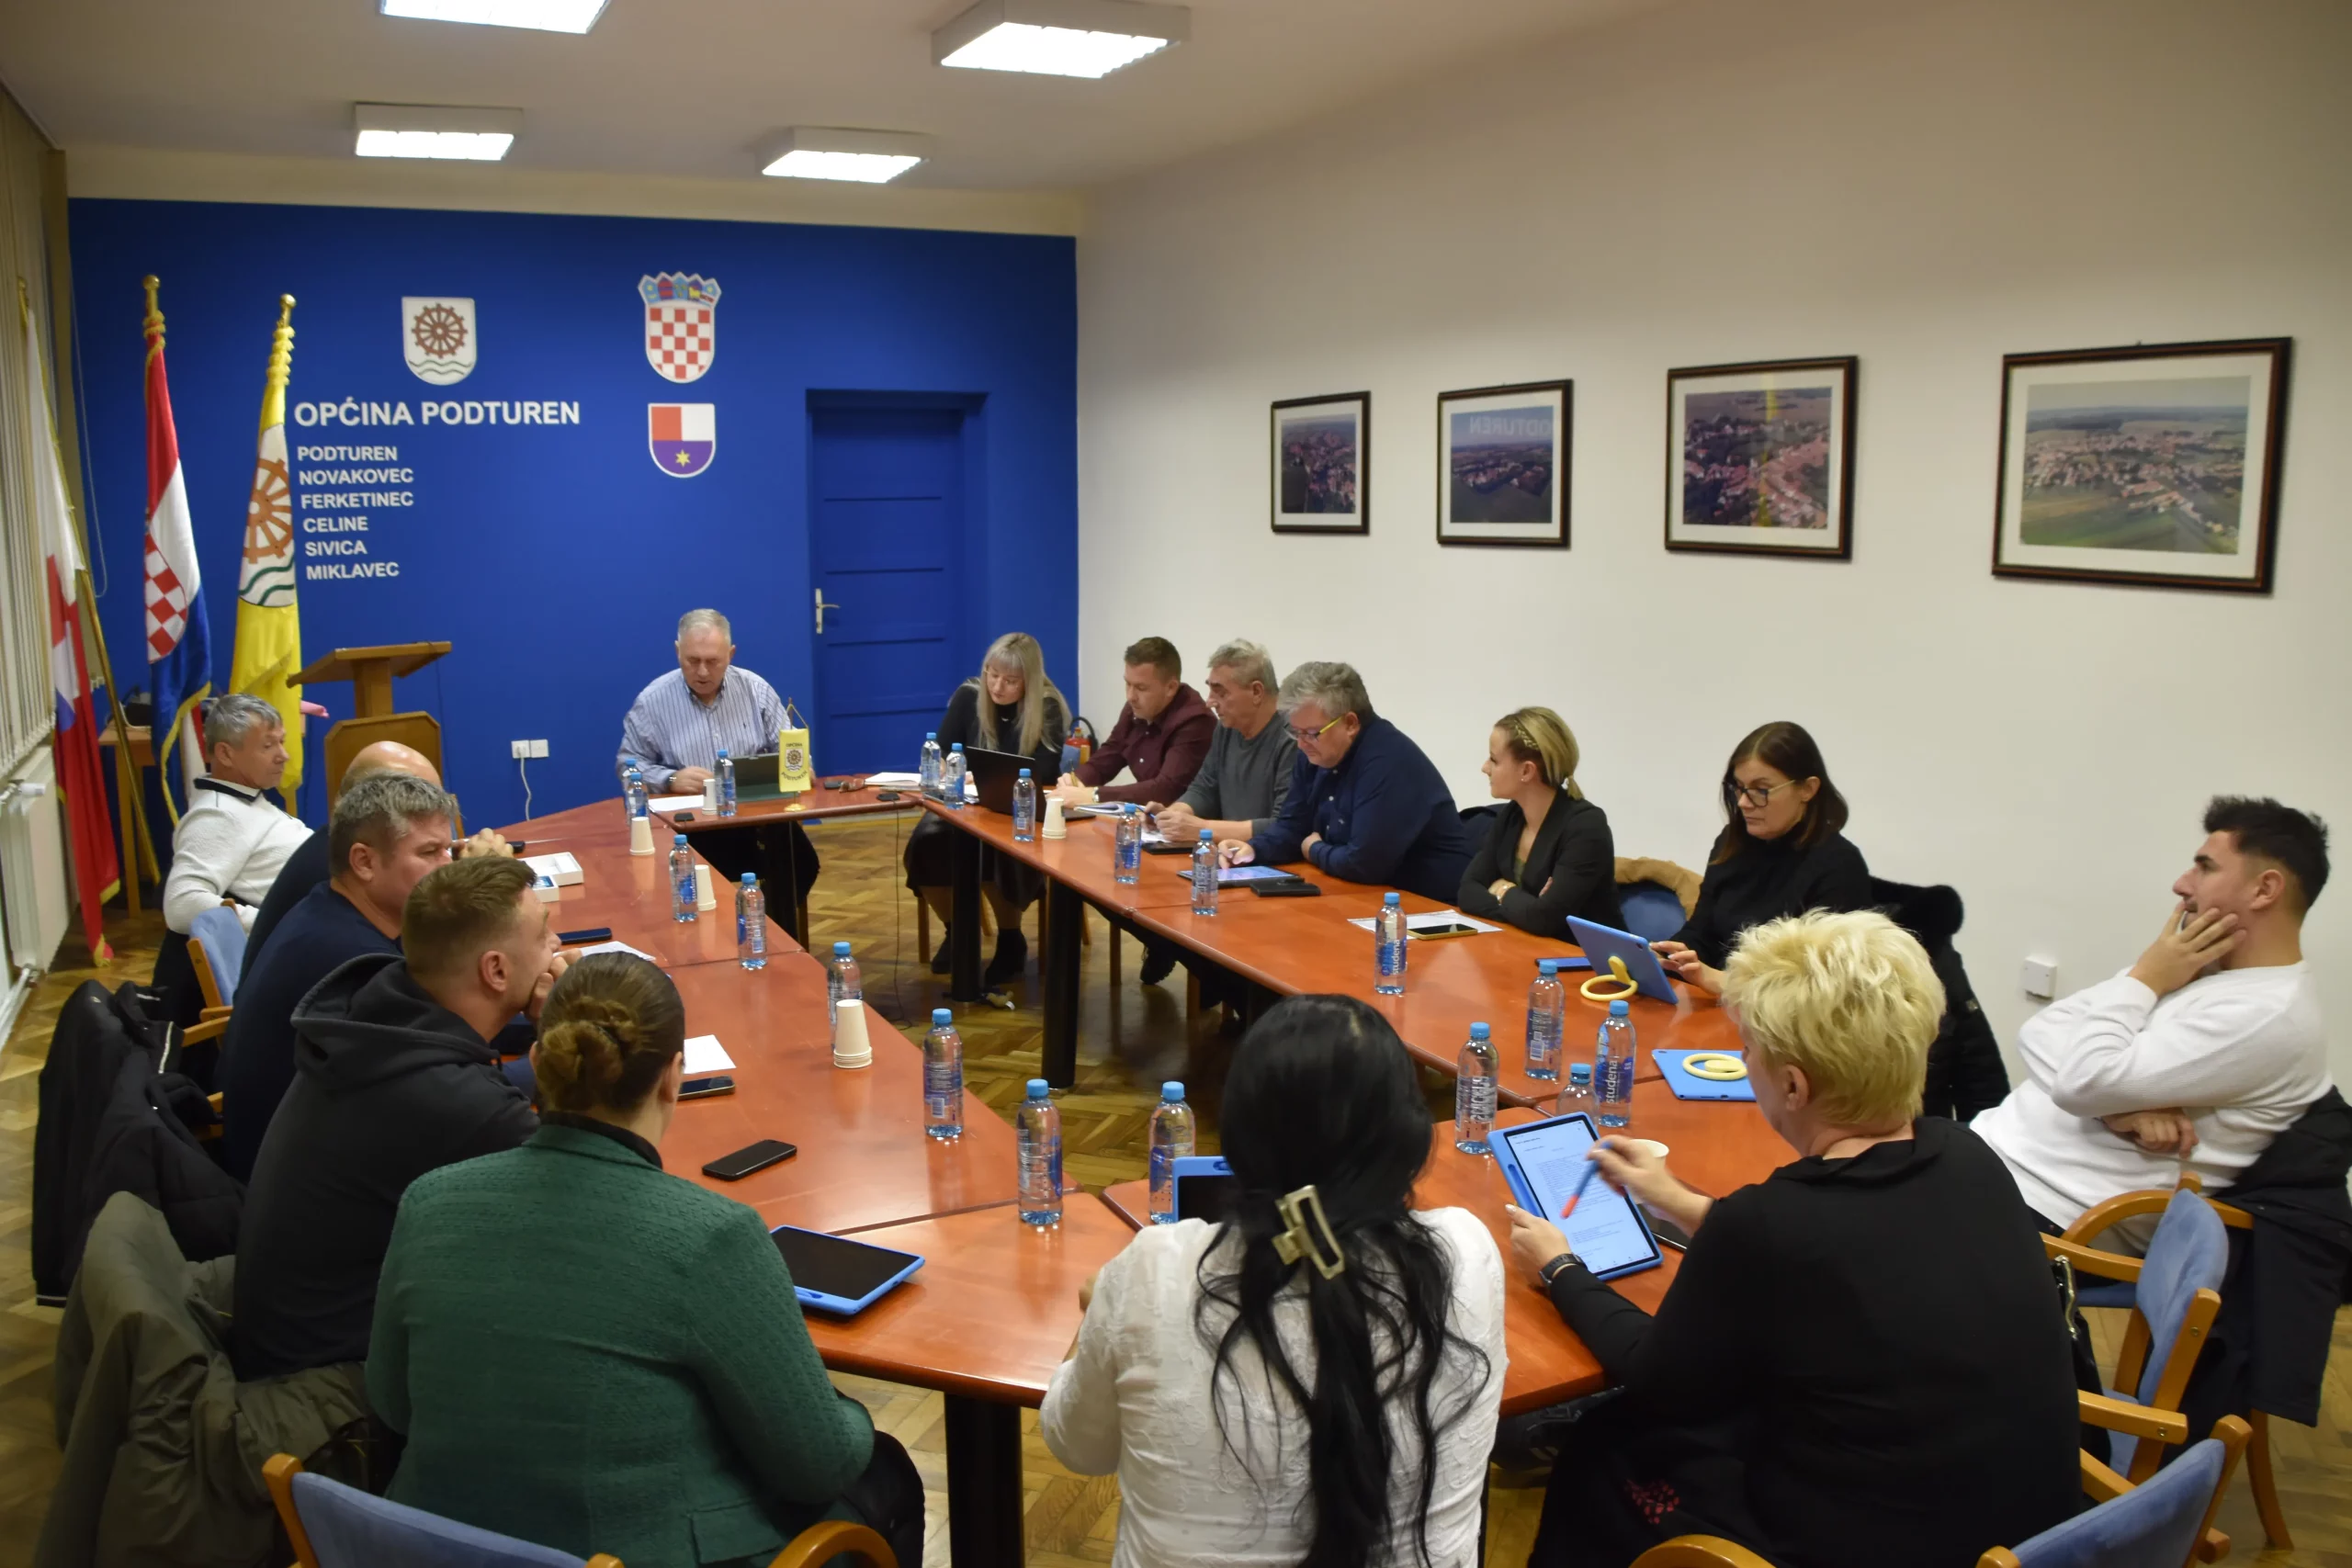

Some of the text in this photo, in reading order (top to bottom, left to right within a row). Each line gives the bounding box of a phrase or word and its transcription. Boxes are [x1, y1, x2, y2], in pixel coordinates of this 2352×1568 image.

[293, 396, 581, 427] OPĆINA PODTUREN
[297, 446, 398, 462] PODTUREN
[299, 468, 414, 486] NOVAKOVEC
[300, 491, 414, 510] FERKETINEC
[302, 515, 368, 534] CELINE
[304, 539, 368, 558] SIVICA
[306, 561, 401, 581] MIKLAVEC
[1392, 939, 1401, 976] studena
[1605, 1060, 1618, 1104] studena
